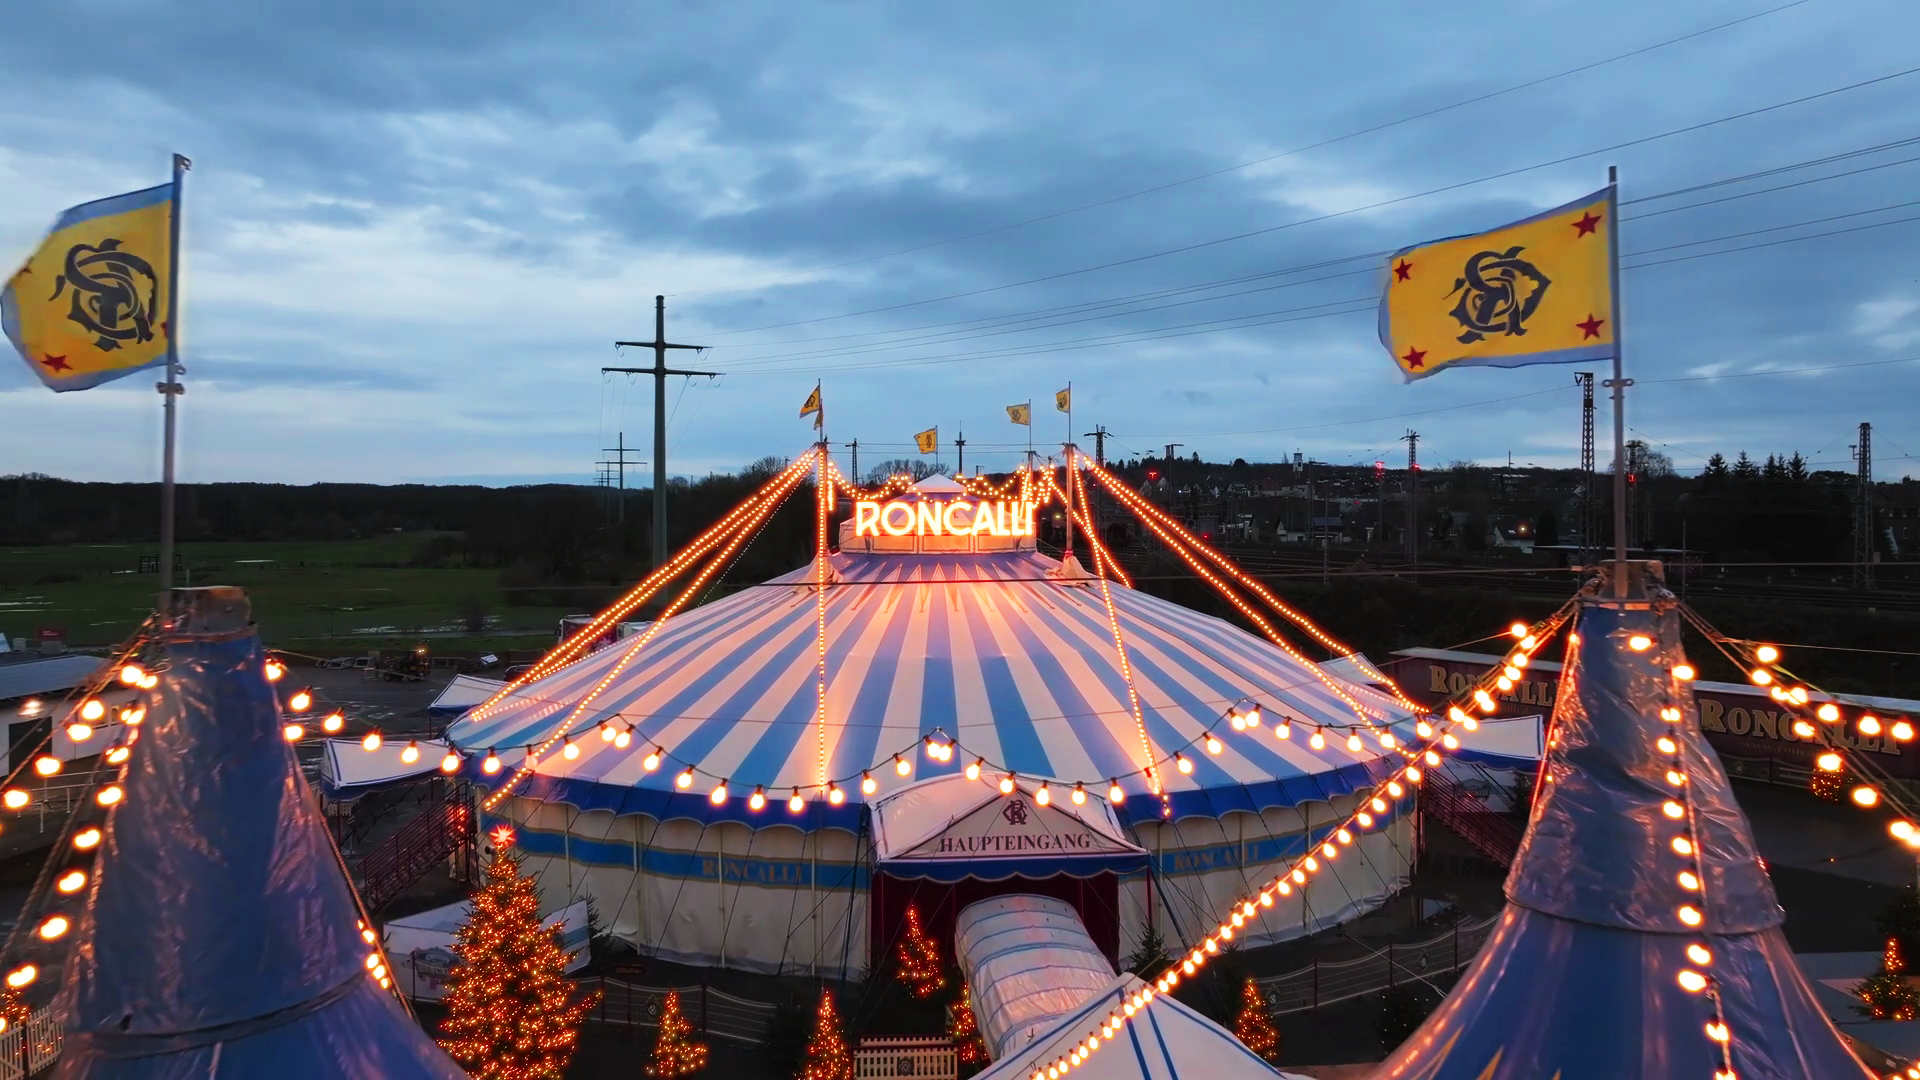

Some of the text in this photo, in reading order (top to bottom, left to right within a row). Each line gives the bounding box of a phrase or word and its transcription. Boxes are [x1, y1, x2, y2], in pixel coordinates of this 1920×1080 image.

[855, 501, 1033, 536] RONCALLI
[940, 833, 1090, 852] HAUPTEINGANG
[1174, 844, 1259, 870] RONALLI
